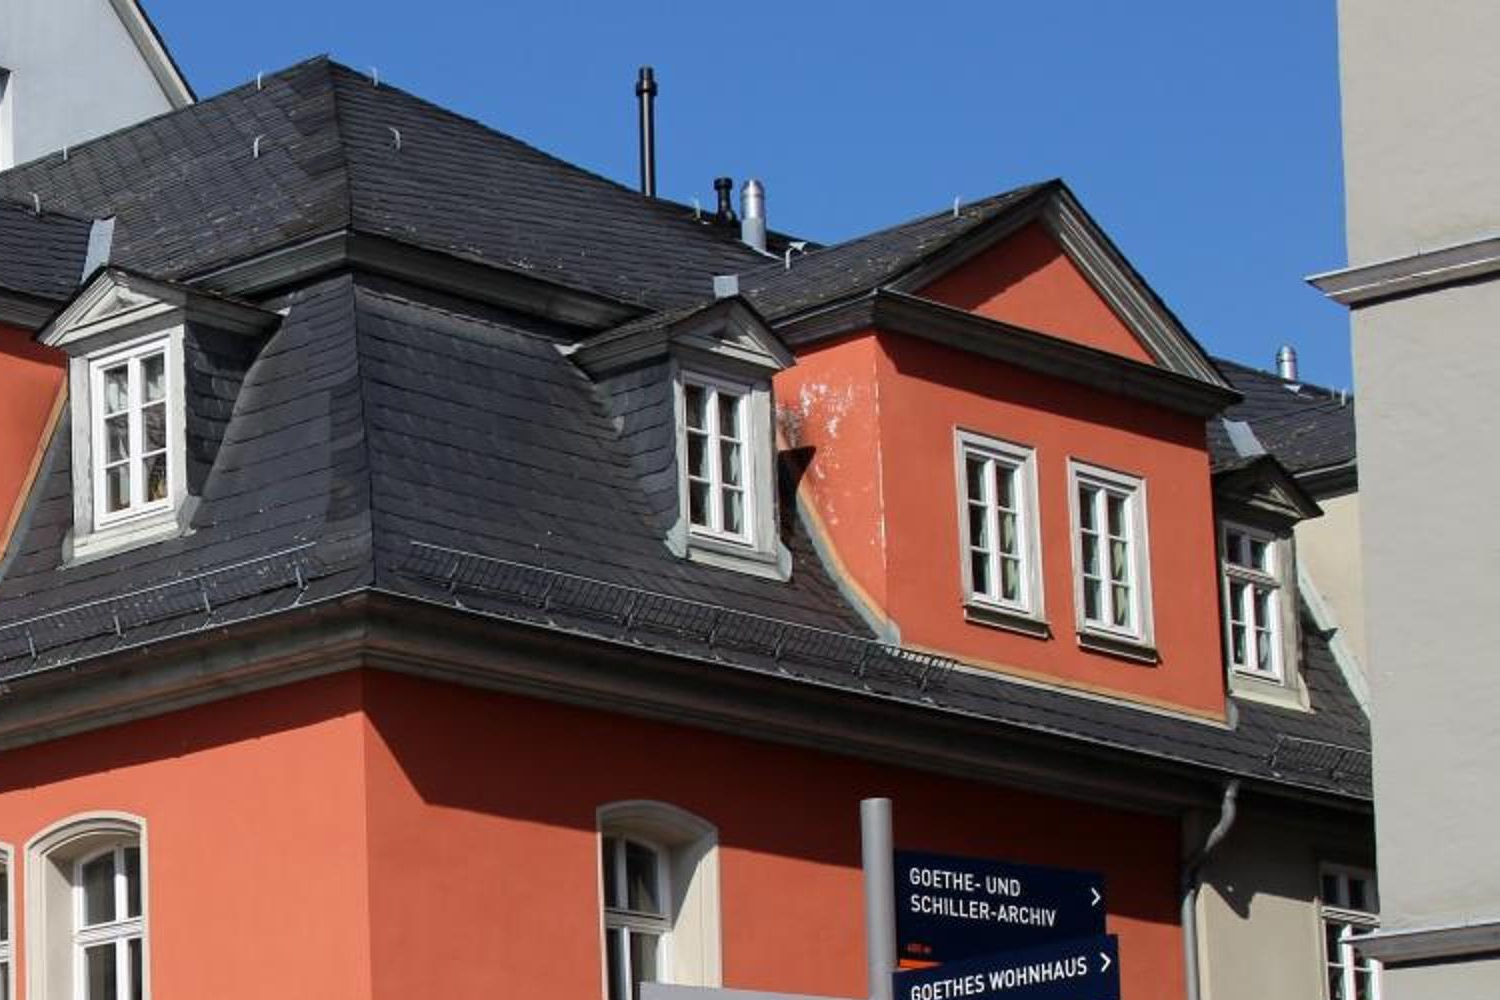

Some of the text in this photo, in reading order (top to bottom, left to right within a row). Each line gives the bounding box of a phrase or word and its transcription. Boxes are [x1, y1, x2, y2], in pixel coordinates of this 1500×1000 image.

[909, 867, 1021, 896] GOETHE- UND
[910, 894, 1057, 927] SCHILLER-ARCHIV
[989, 956, 1088, 991] WOHNHAUS
